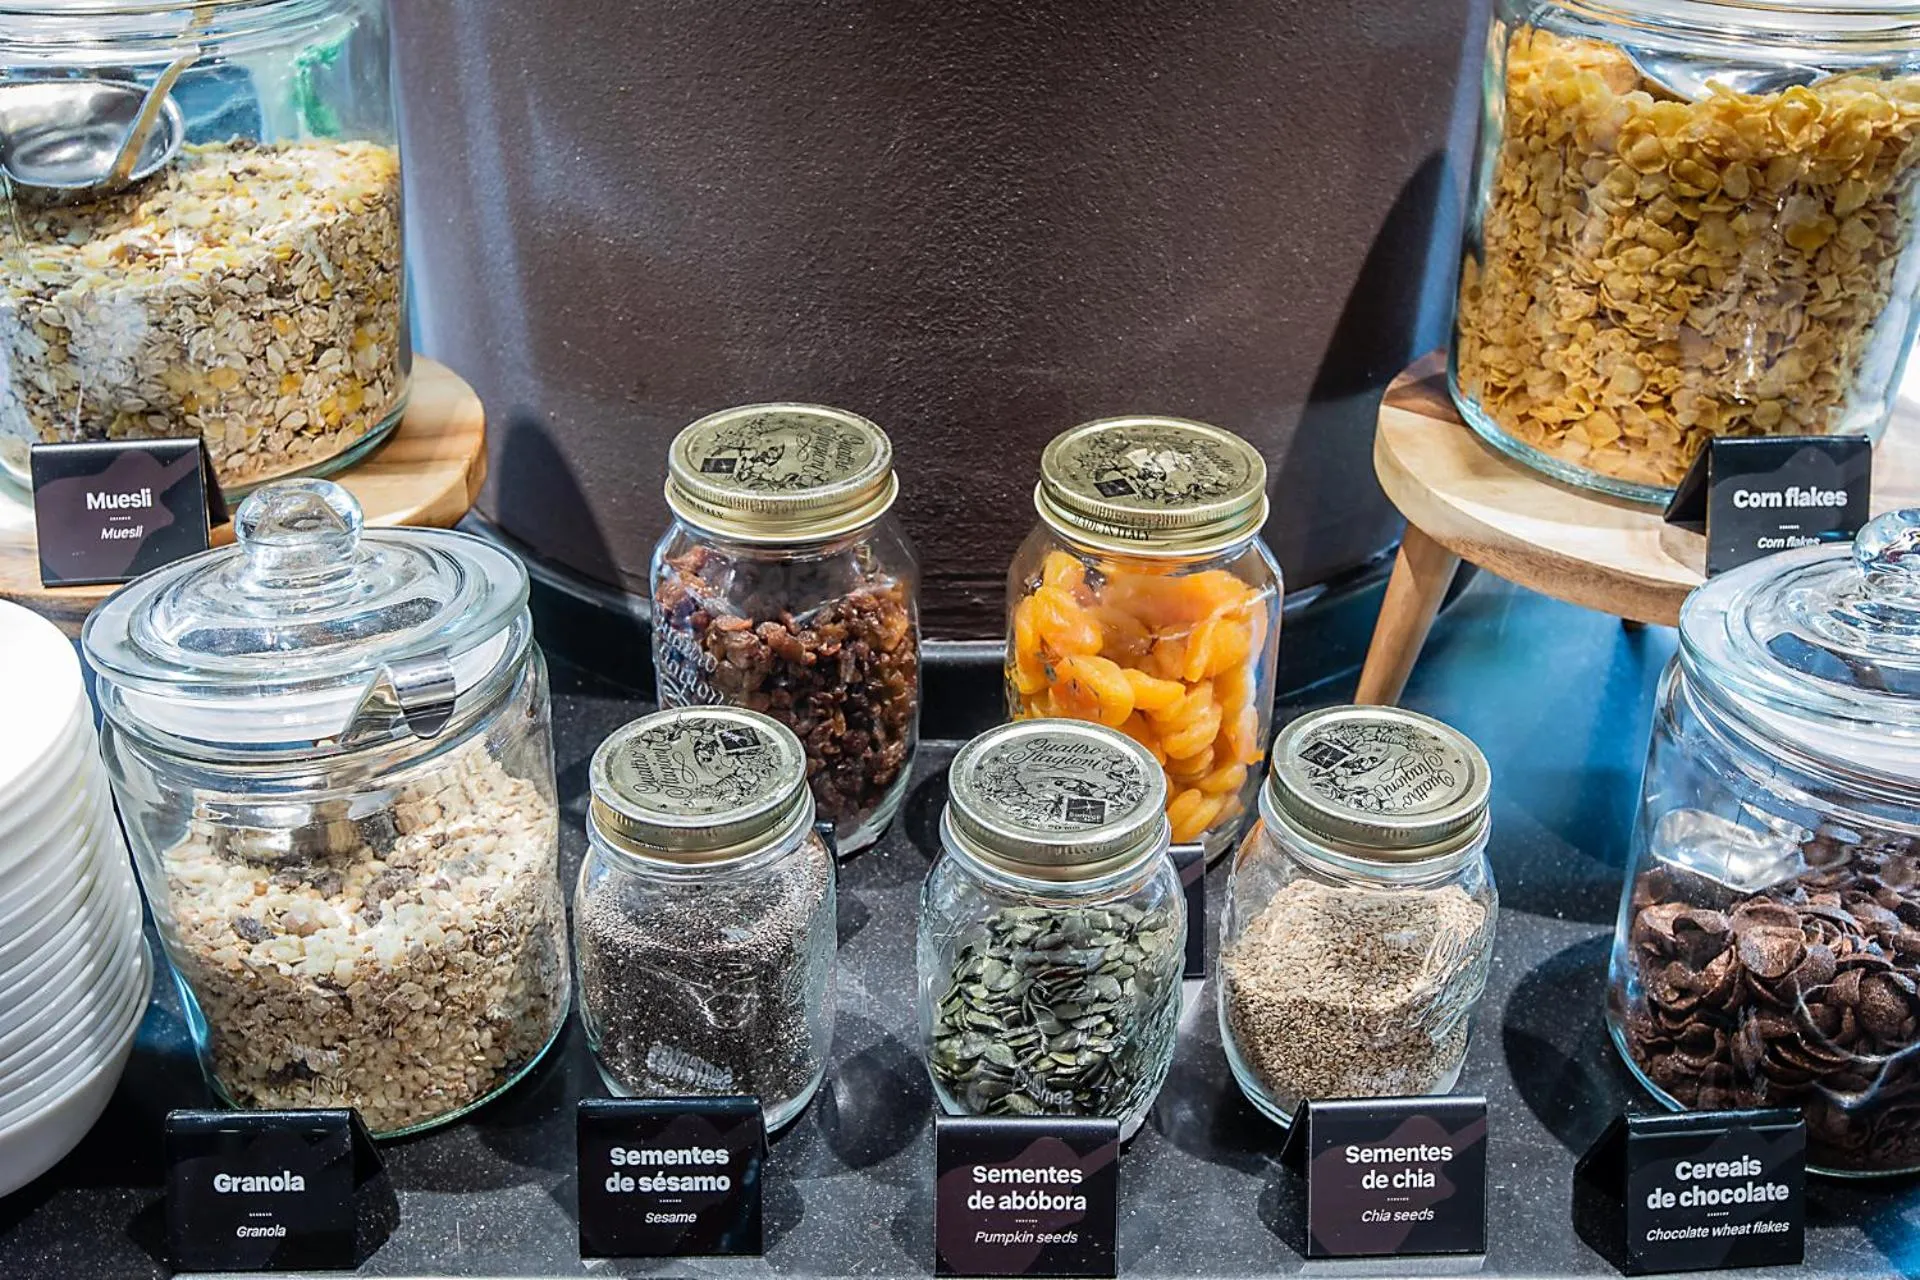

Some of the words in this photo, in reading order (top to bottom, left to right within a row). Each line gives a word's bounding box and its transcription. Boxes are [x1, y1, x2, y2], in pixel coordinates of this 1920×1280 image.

[87, 488, 152, 509] Muesli
[1733, 489, 1783, 508] Corn
[1785, 486, 1848, 508] flakes
[101, 525, 143, 539] Muesli
[1118, 525, 1152, 541] ITALY
[1757, 536, 1785, 549] Corn
[1786, 535, 1821, 548] flakes
[1025, 738, 1101, 755] Quattro
[1006, 751, 1109, 772] Stagioni
[1373, 750, 1444, 802] Stagioni
[1402, 768, 1455, 809] Quattro
[611, 1147, 729, 1165] Sementes
[1346, 1144, 1452, 1163] Sementes
[973, 1166, 1082, 1183] Sementes
[1676, 1155, 1761, 1180] Cereais
[214, 1171, 304, 1192] Granola
[606, 1172, 634, 1192] de
[639, 1171, 730, 1191] sésamo
[1362, 1170, 1389, 1189] de
[1393, 1168, 1435, 1188] chia
[968, 1190, 995, 1209] de
[999, 1190, 1086, 1210] abóbora
[1647, 1188, 1675, 1209] de
[1680, 1182, 1788, 1206] chocolate
[645, 1213, 696, 1223] Sesame
[1362, 1209, 1391, 1222] Chia
[1394, 1208, 1434, 1221] seeds
[237, 1224, 286, 1237] Granola
[975, 1231, 1033, 1245] Pumpkin
[1037, 1231, 1078, 1243] seeds
[1645, 1225, 1709, 1242] Chocolate
[1711, 1222, 1751, 1237] wheat
[1752, 1220, 1790, 1235] flakes
